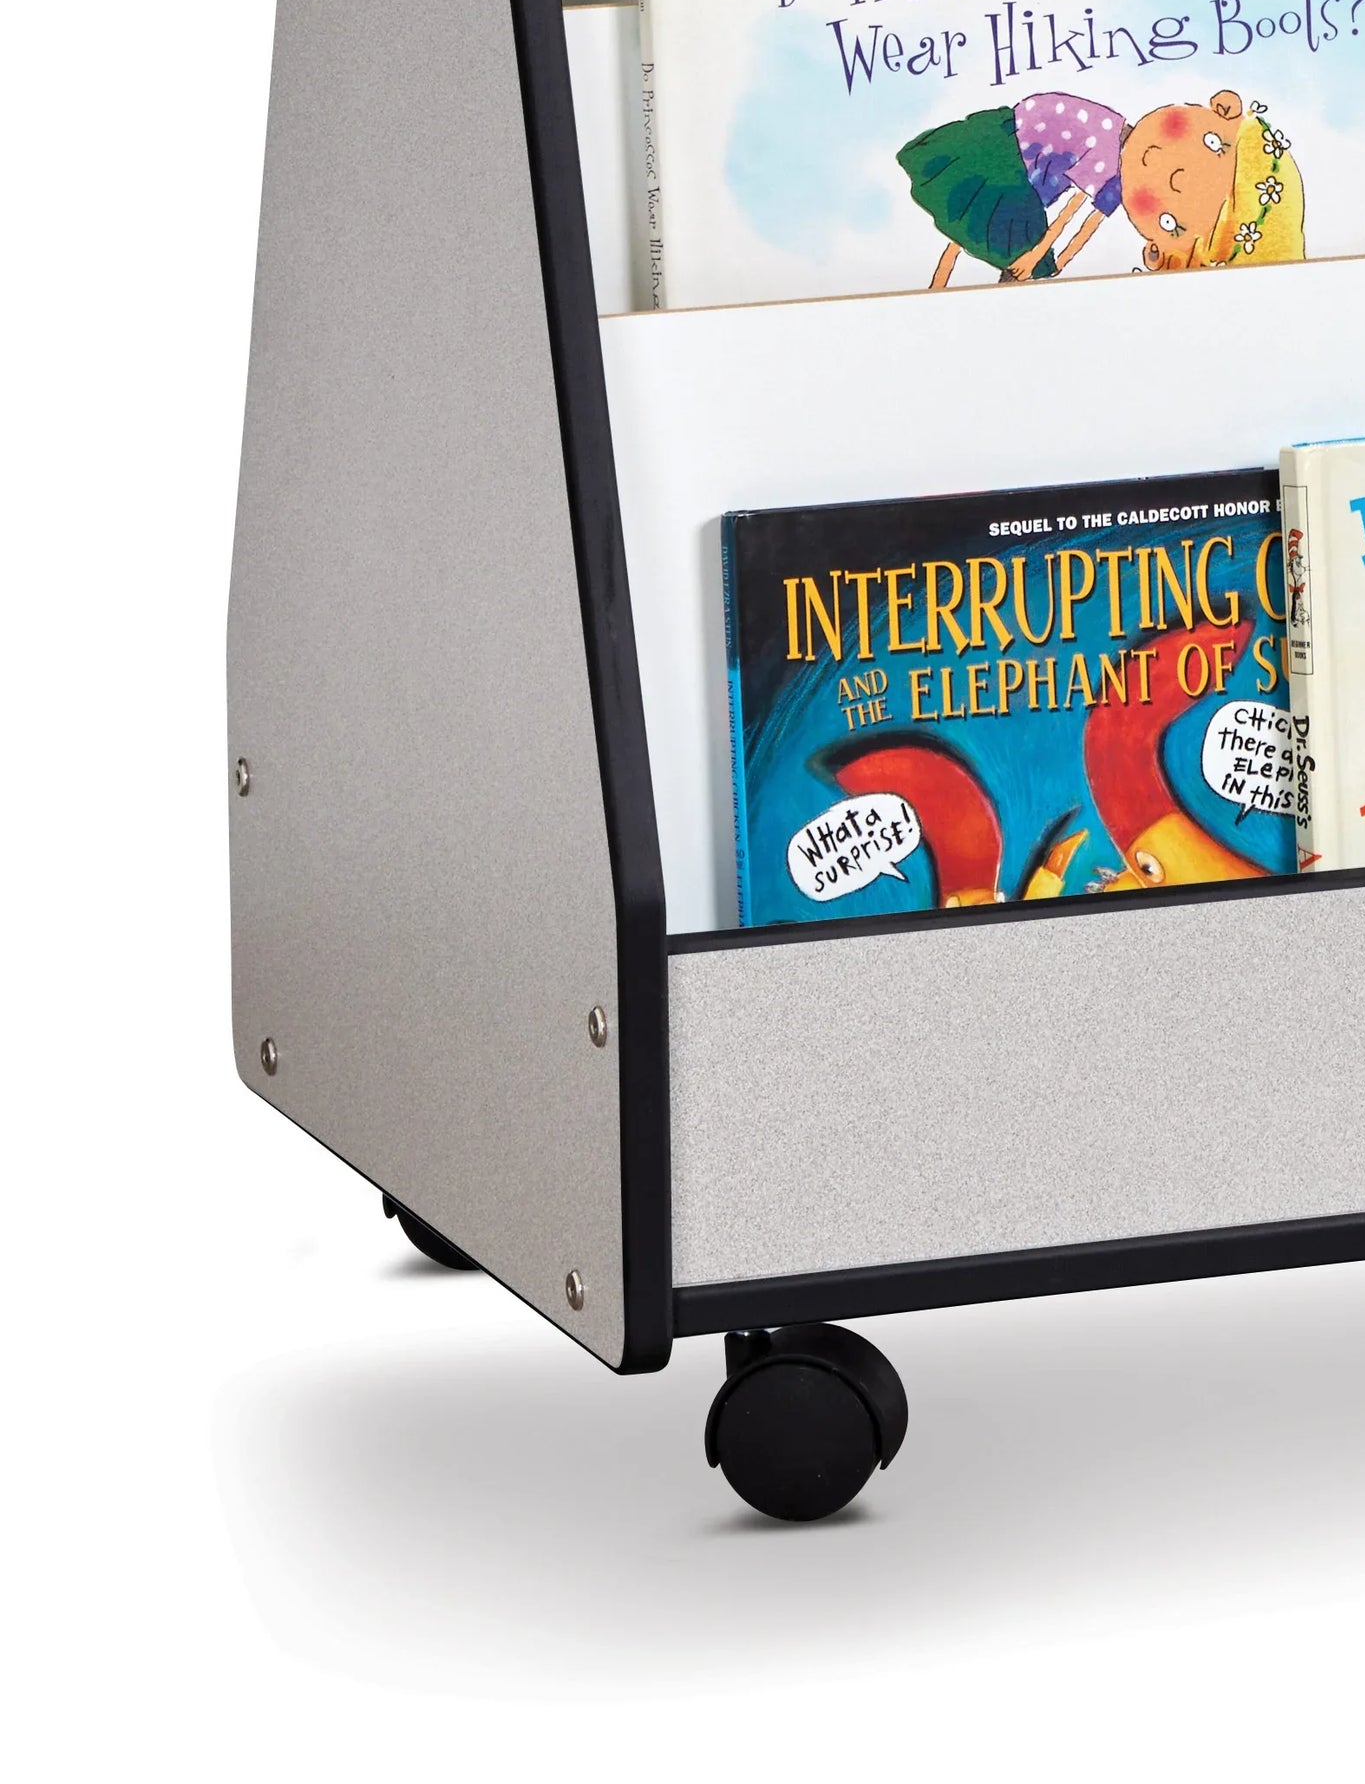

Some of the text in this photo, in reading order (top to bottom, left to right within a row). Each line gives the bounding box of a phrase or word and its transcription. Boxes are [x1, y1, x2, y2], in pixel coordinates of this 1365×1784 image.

[826, 18, 968, 96] Wear
[984, 1, 1199, 86] Hiking
[642, 63, 654, 82] Do
[988, 518, 1052, 538] SEQUEL
[1056, 516, 1078, 532] TO
[1082, 512, 1112, 528] THE
[1117, 504, 1209, 526] CALDECOTT
[1213, 499, 1270, 518] HONOR
[782, 536, 1240, 666] INTERRUPTING
[837, 667, 889, 705] AND
[910, 648, 1158, 722] ELEPHANT
[1176, 642, 1239, 698] OF
[841, 698, 893, 731] THE
[1218, 727, 1276, 759] there
[1293, 716, 1316, 829] Dr. Seuss's
[1250, 784, 1294, 809] this
